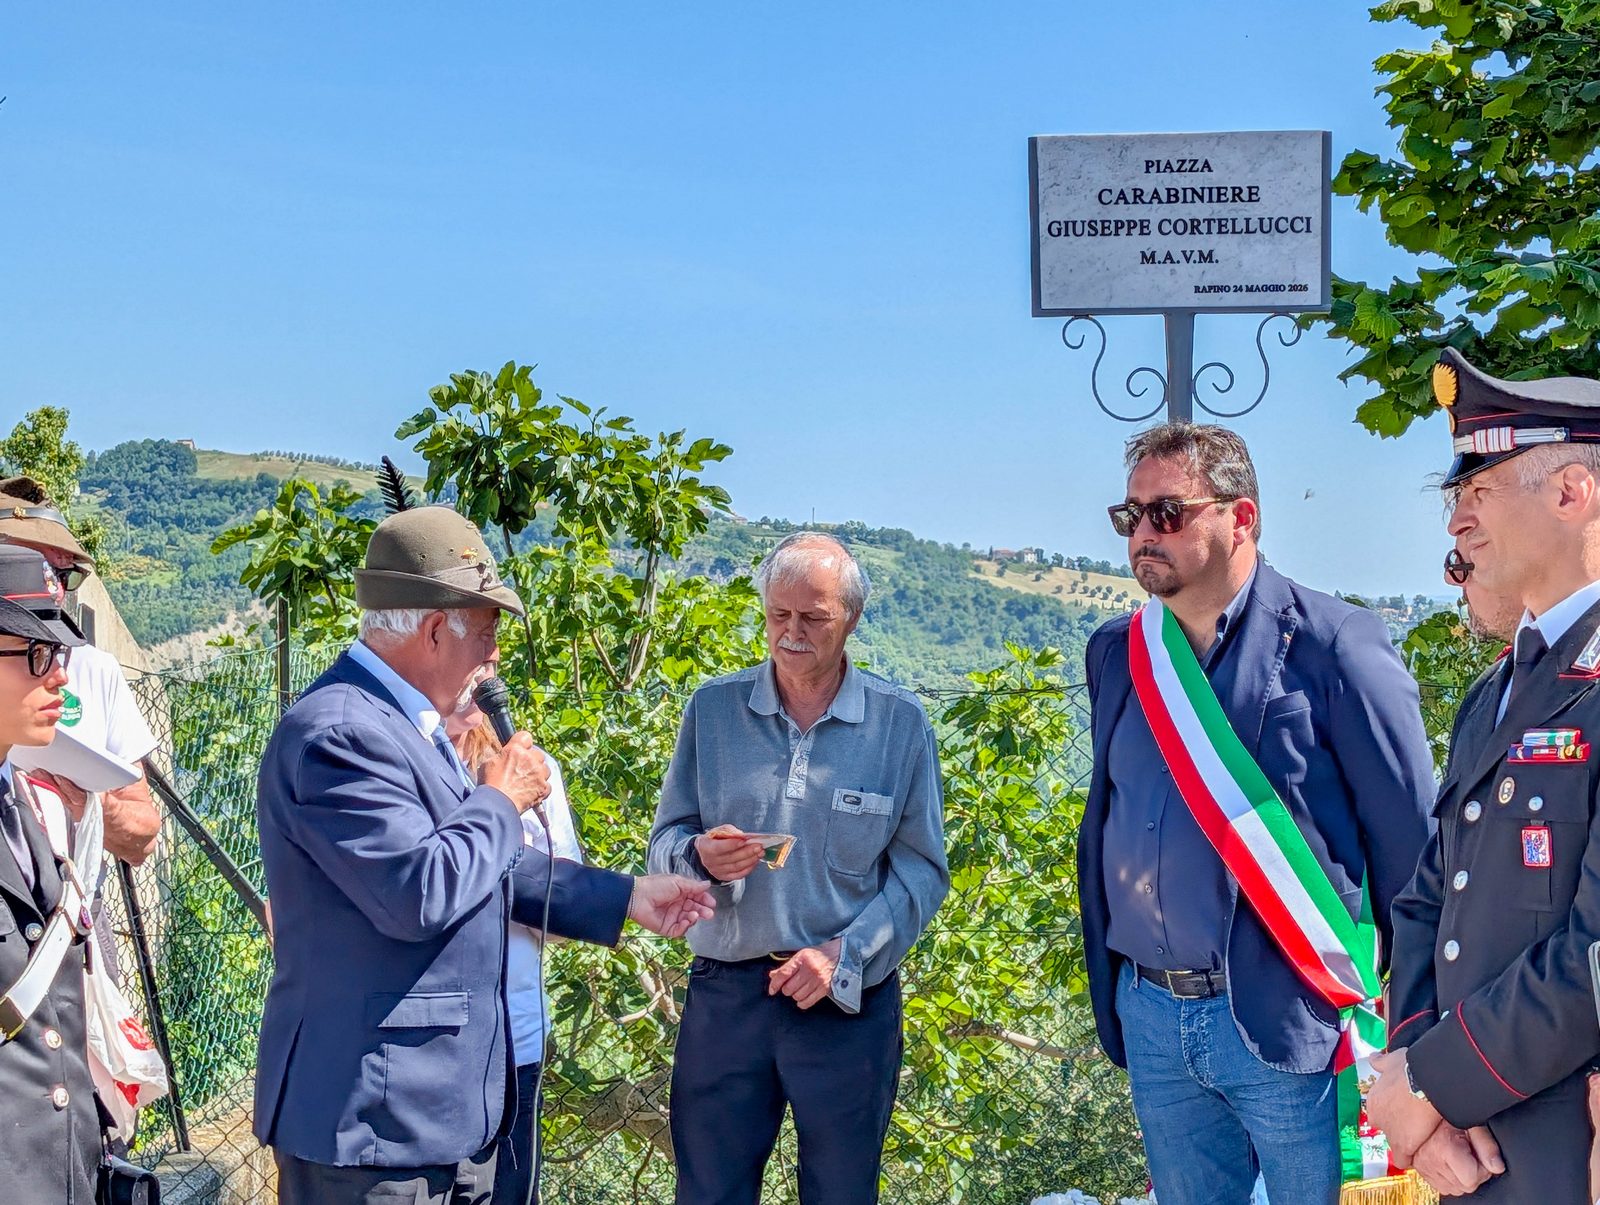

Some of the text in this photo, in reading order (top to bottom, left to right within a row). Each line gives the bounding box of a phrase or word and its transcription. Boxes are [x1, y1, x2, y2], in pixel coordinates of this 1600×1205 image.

[1143, 158, 1213, 174] PIAZZA
[1097, 185, 1261, 205] CARABINIERE
[1047, 216, 1313, 238] GIUSEPPE CORTELLUCCI
[1139, 249, 1220, 265] M.A.V.M.
[1193, 283, 1309, 294] RAPINO 24 MAGGIO 2026
